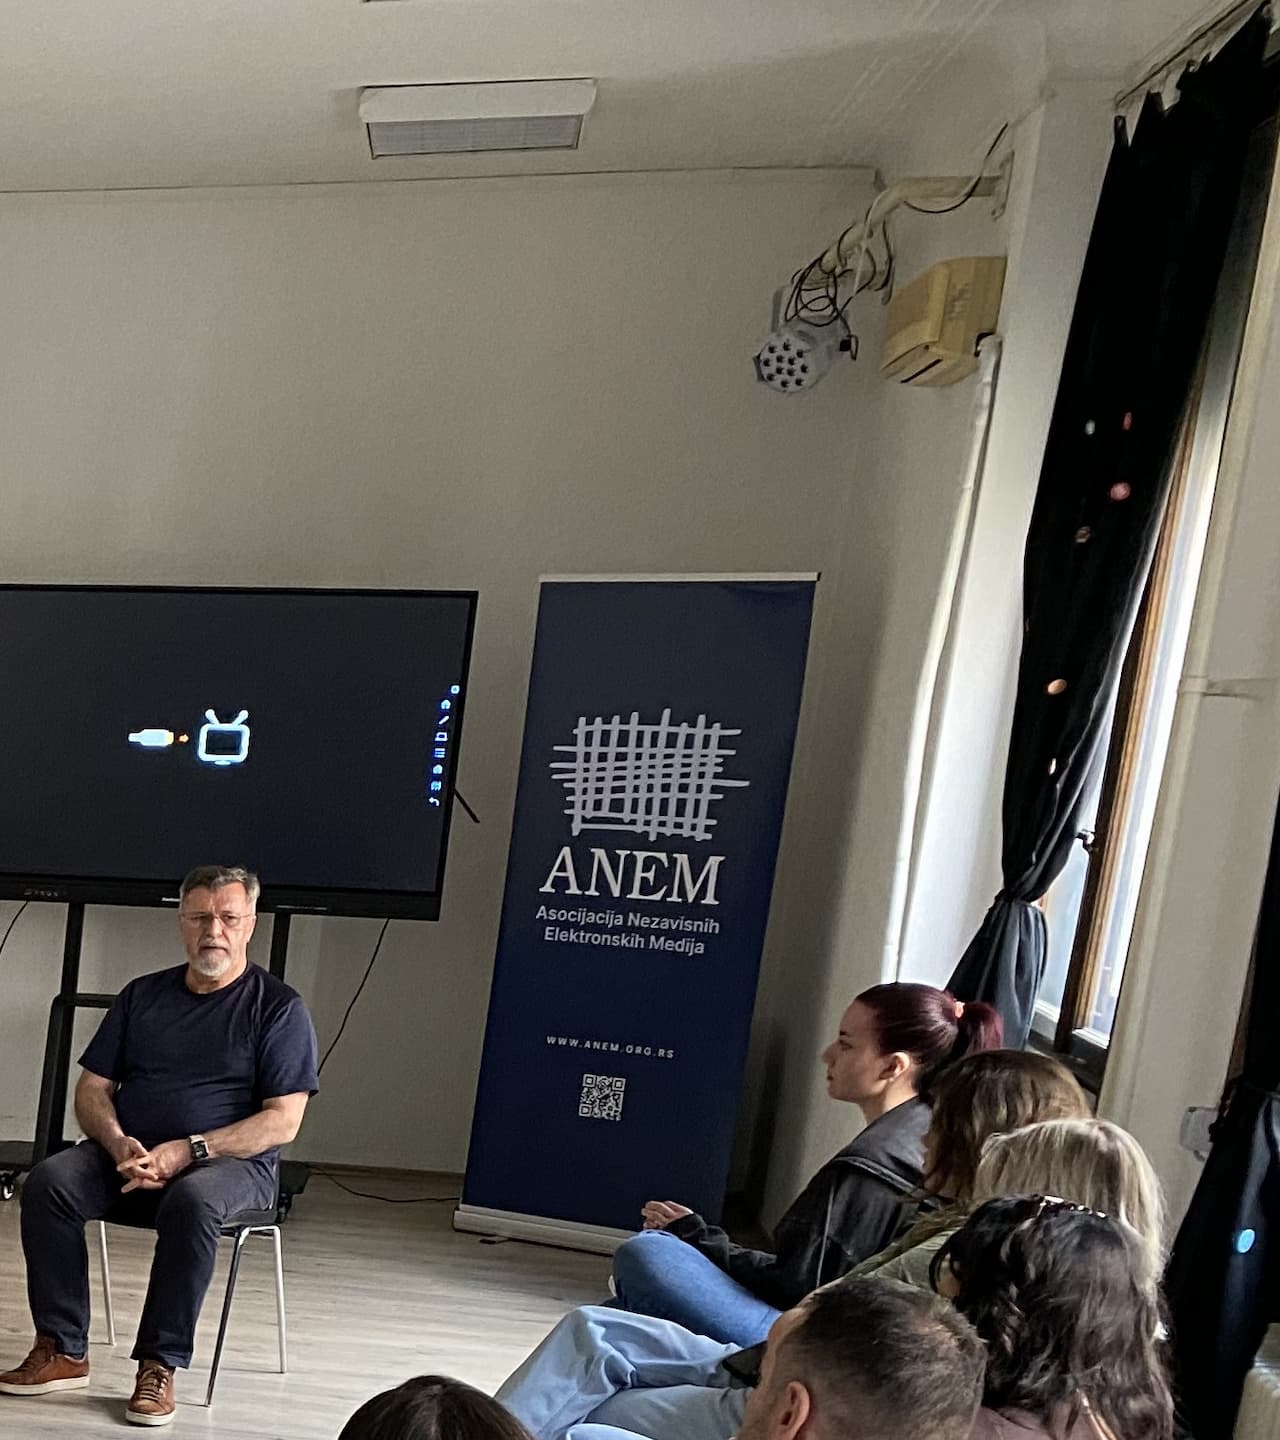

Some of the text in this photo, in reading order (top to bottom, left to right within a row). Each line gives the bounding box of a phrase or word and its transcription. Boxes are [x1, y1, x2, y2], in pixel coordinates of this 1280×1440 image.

[539, 846, 725, 905] ANEM
[535, 905, 720, 934] Asocijacija Nezavisnih
[544, 927, 705, 956] Elektronskih Medija
[546, 1034, 675, 1059] WWW.ANEM.ORG.RS
